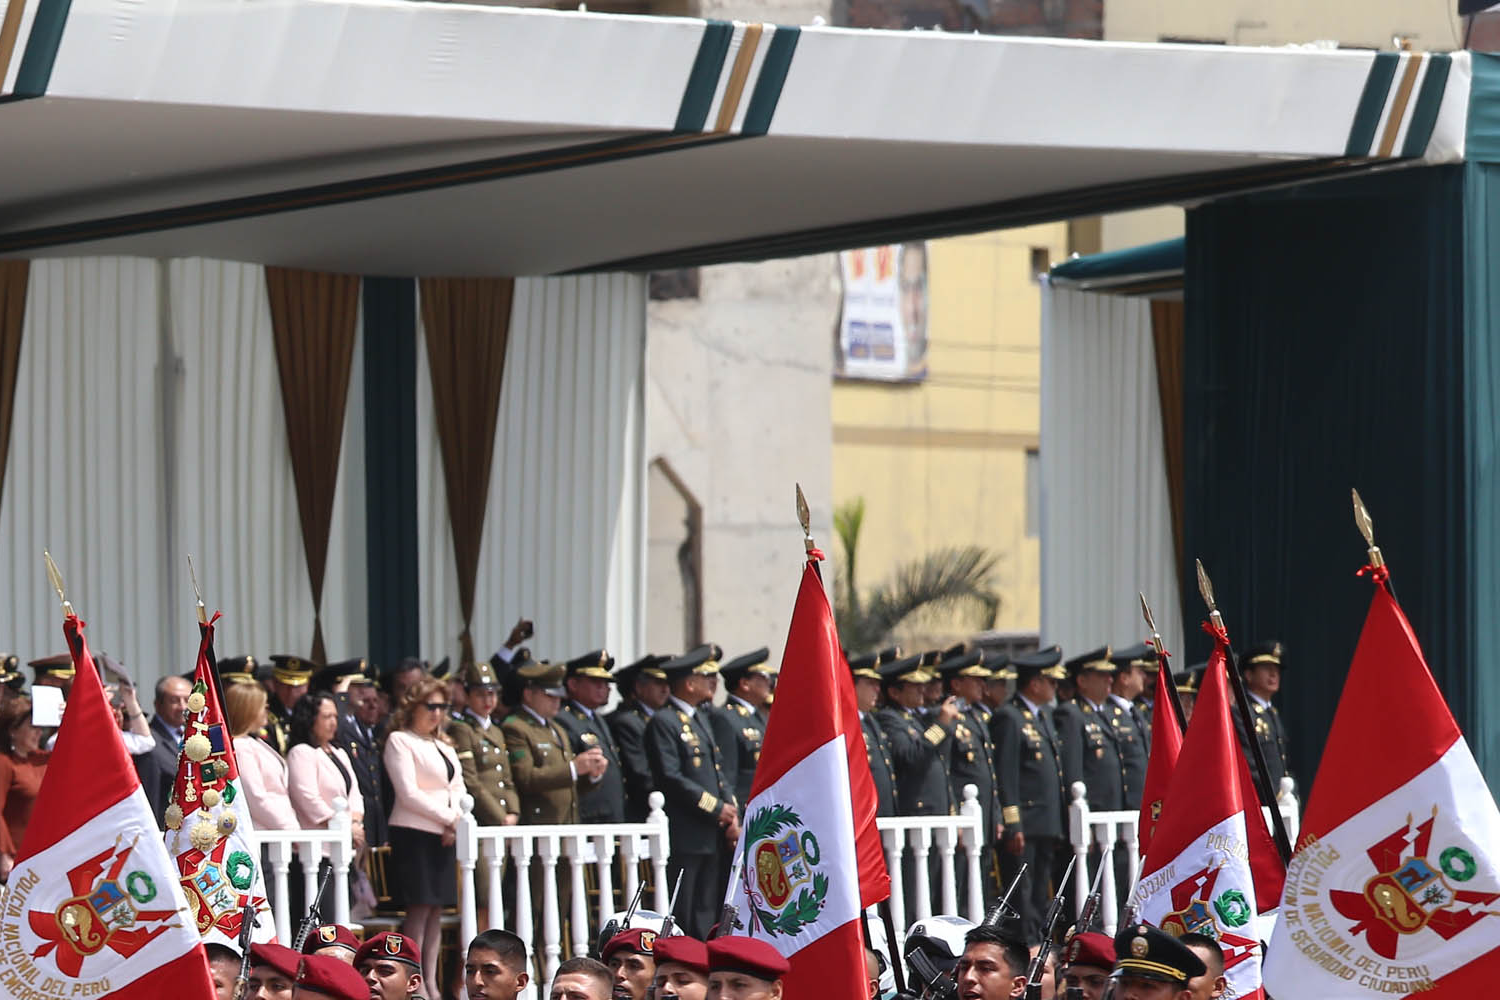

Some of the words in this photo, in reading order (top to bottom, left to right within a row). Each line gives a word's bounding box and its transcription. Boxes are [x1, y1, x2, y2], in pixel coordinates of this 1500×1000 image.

[6, 868, 40, 918] POLICIA
[1285, 909, 1303, 928] DE
[3, 922, 41, 985] NACIONAL
[1291, 929, 1356, 981] SEGURIDAD
[1302, 903, 1355, 960] NACIONAL
[1354, 955, 1382, 977] DEL
[1386, 964, 1429, 979] PERU
[40, 977, 67, 996] DEL
[71, 976, 111, 997] PERÚ
[1358, 974, 1438, 994] CIUDADANA
